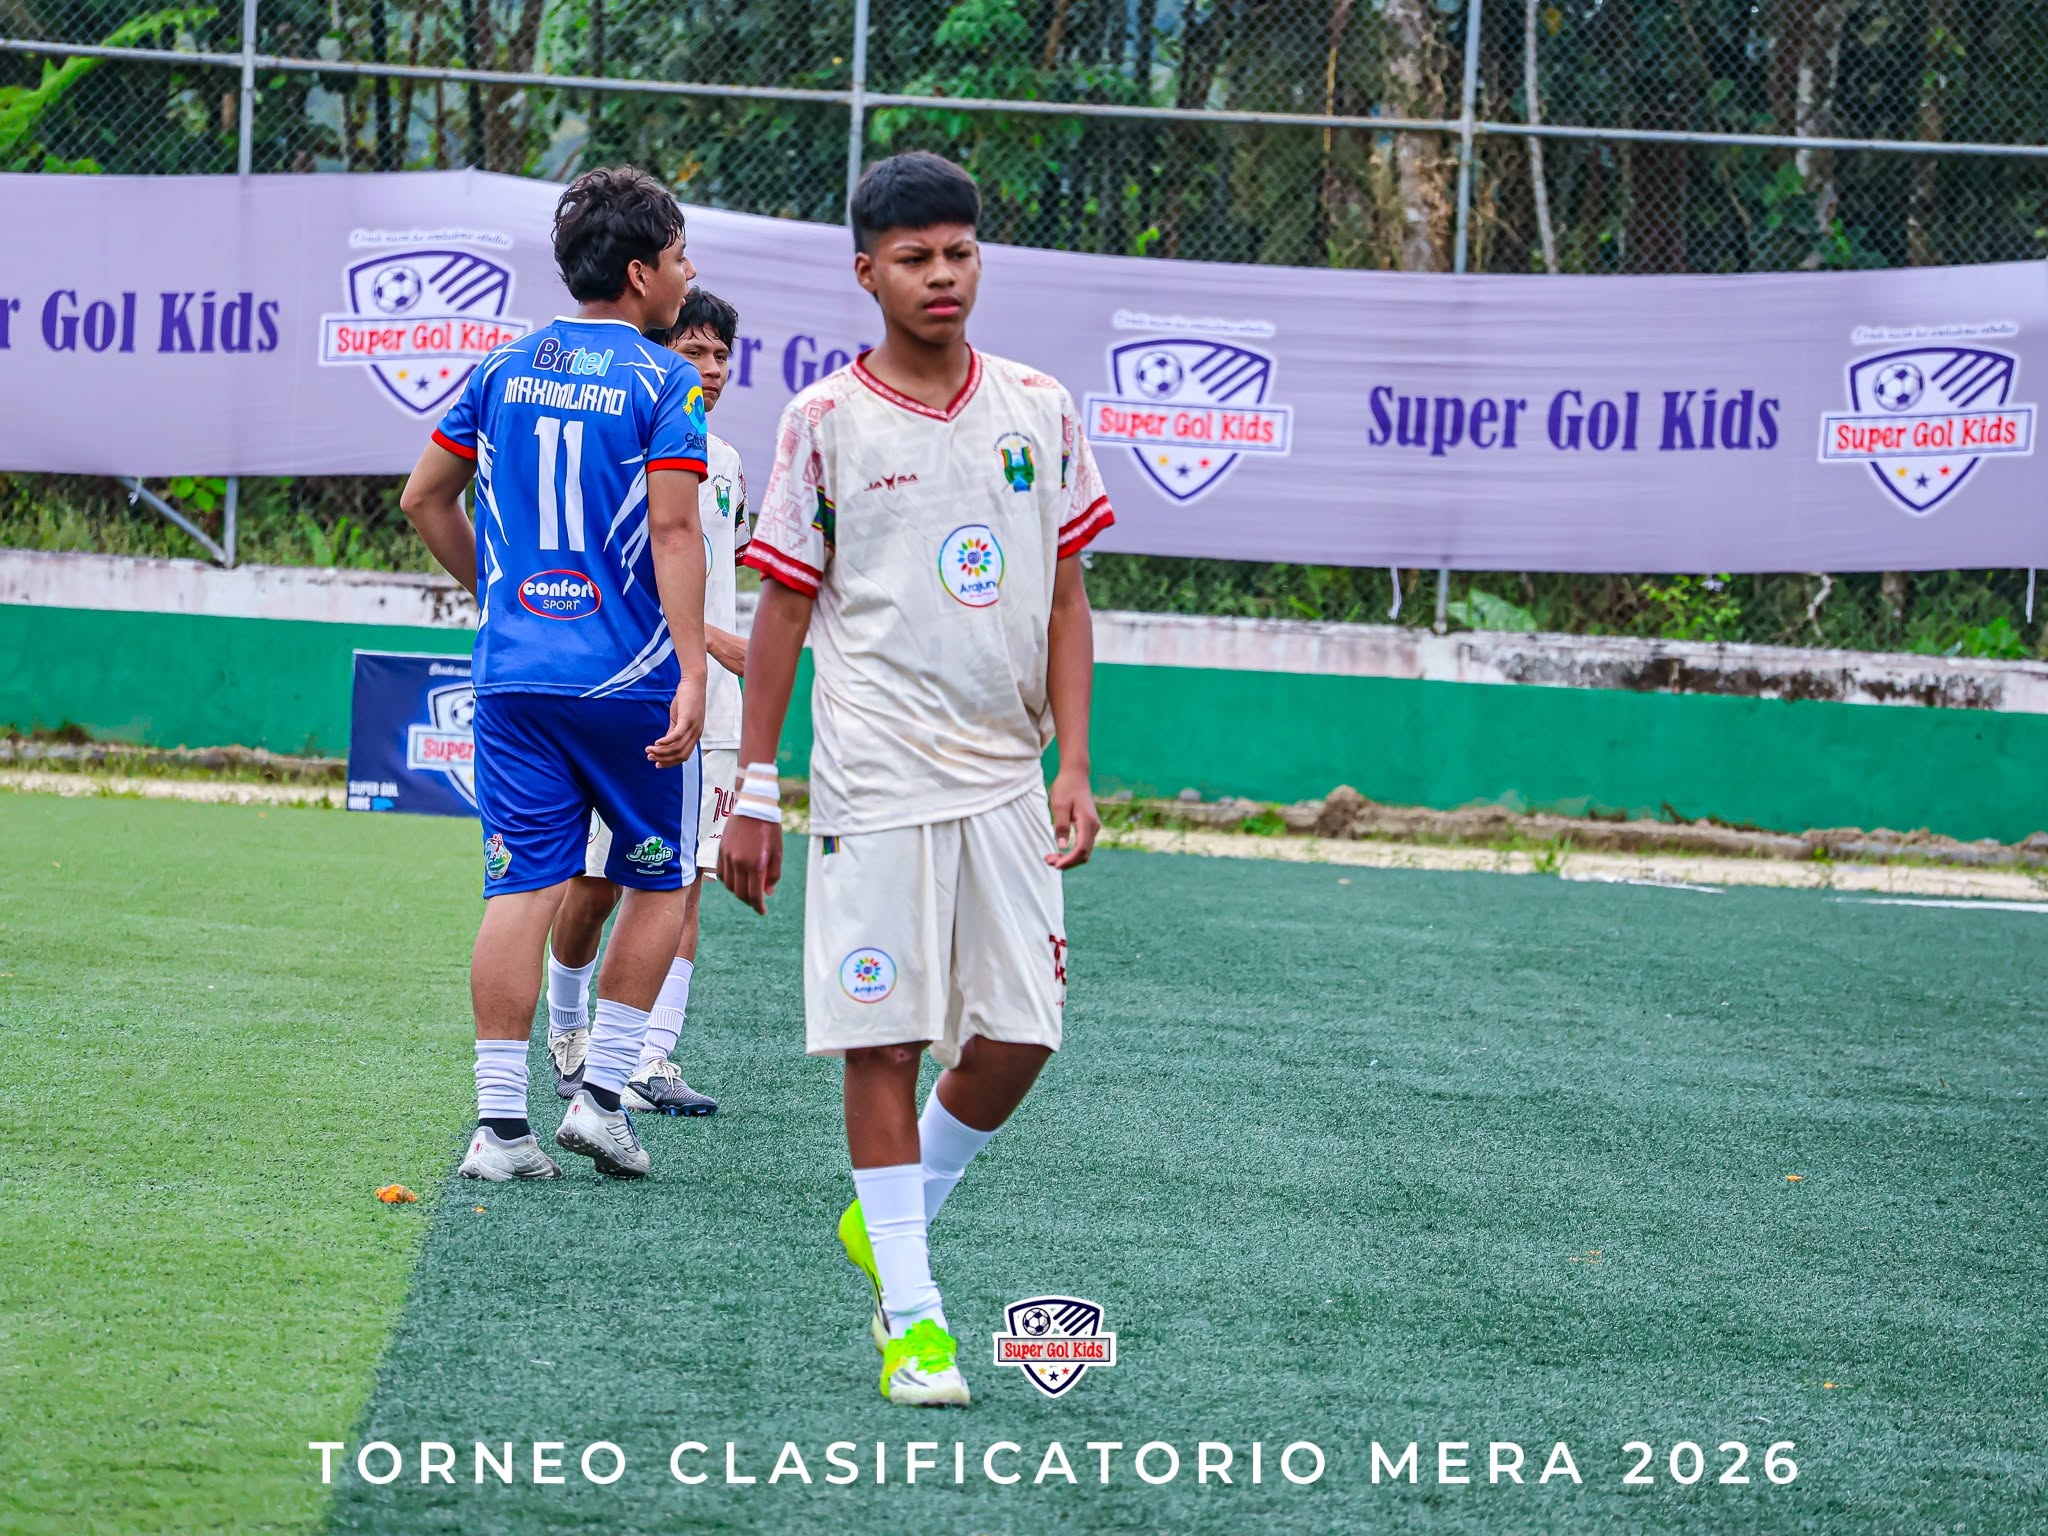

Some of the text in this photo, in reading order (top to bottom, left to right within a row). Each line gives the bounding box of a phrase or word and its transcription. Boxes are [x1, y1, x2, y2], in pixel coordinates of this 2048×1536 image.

[42, 289, 136, 352] Gol
[157, 291, 280, 353] Kids
[337, 325, 406, 356] Super
[412, 321, 451, 350] Gol
[532, 337, 614, 377] Britel
[783, 335, 873, 394] Go
[504, 376, 627, 416] MAXIMLIANO
[1099, 407, 1274, 443] Super Gol Kids
[1368, 386, 1781, 456] Super Gol Kids
[1837, 416, 2017, 453] Super Gol Kids
[534, 416, 586, 552] 11
[522, 579, 595, 598] confort
[542, 600, 581, 611] SPORT
[424, 737, 475, 762] Super
[627, 844, 673, 863] Jungla
